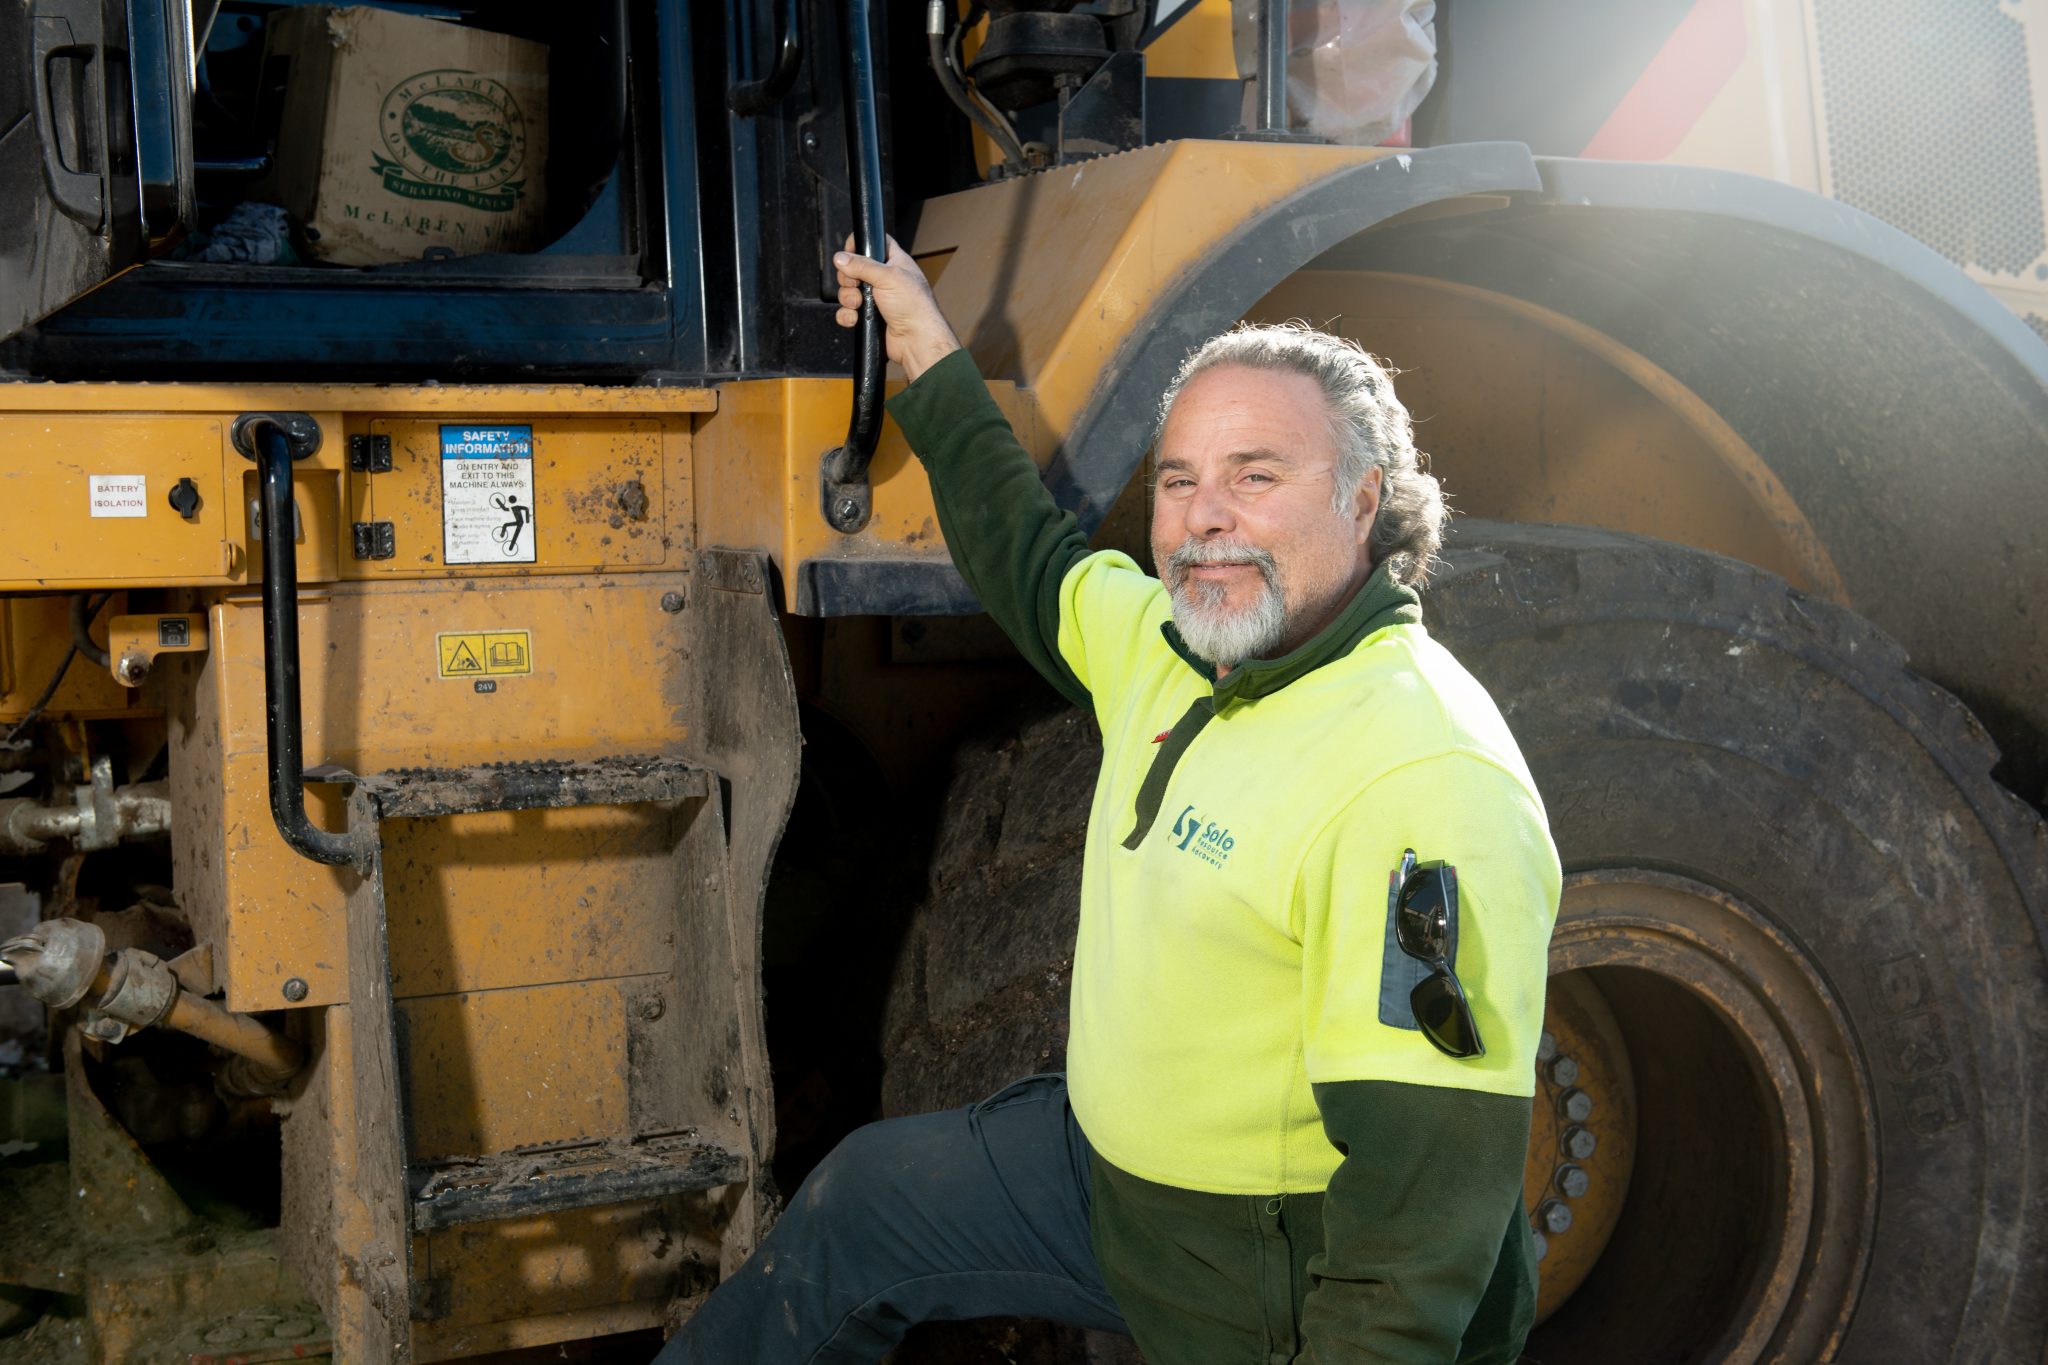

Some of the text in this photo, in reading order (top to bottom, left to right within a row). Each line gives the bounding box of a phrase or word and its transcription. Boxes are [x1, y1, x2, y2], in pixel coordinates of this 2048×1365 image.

[420, 165, 459, 185] THE
[391, 180, 508, 208] SERAFINO WINES
[344, 204, 466, 235] McLAREN
[463, 431, 510, 441] SAFETY
[445, 443, 528, 454] INFORMATION
[457, 463, 469, 471] ON
[472, 463, 499, 471] ENTRY
[461, 472, 480, 480] EXIT
[496, 471, 515, 479] THIS
[97, 485, 139, 493] BATTERY
[450, 481, 488, 489] MACHINE
[478, 683, 493, 691] 24V
[1201, 821, 1235, 851] Solo
